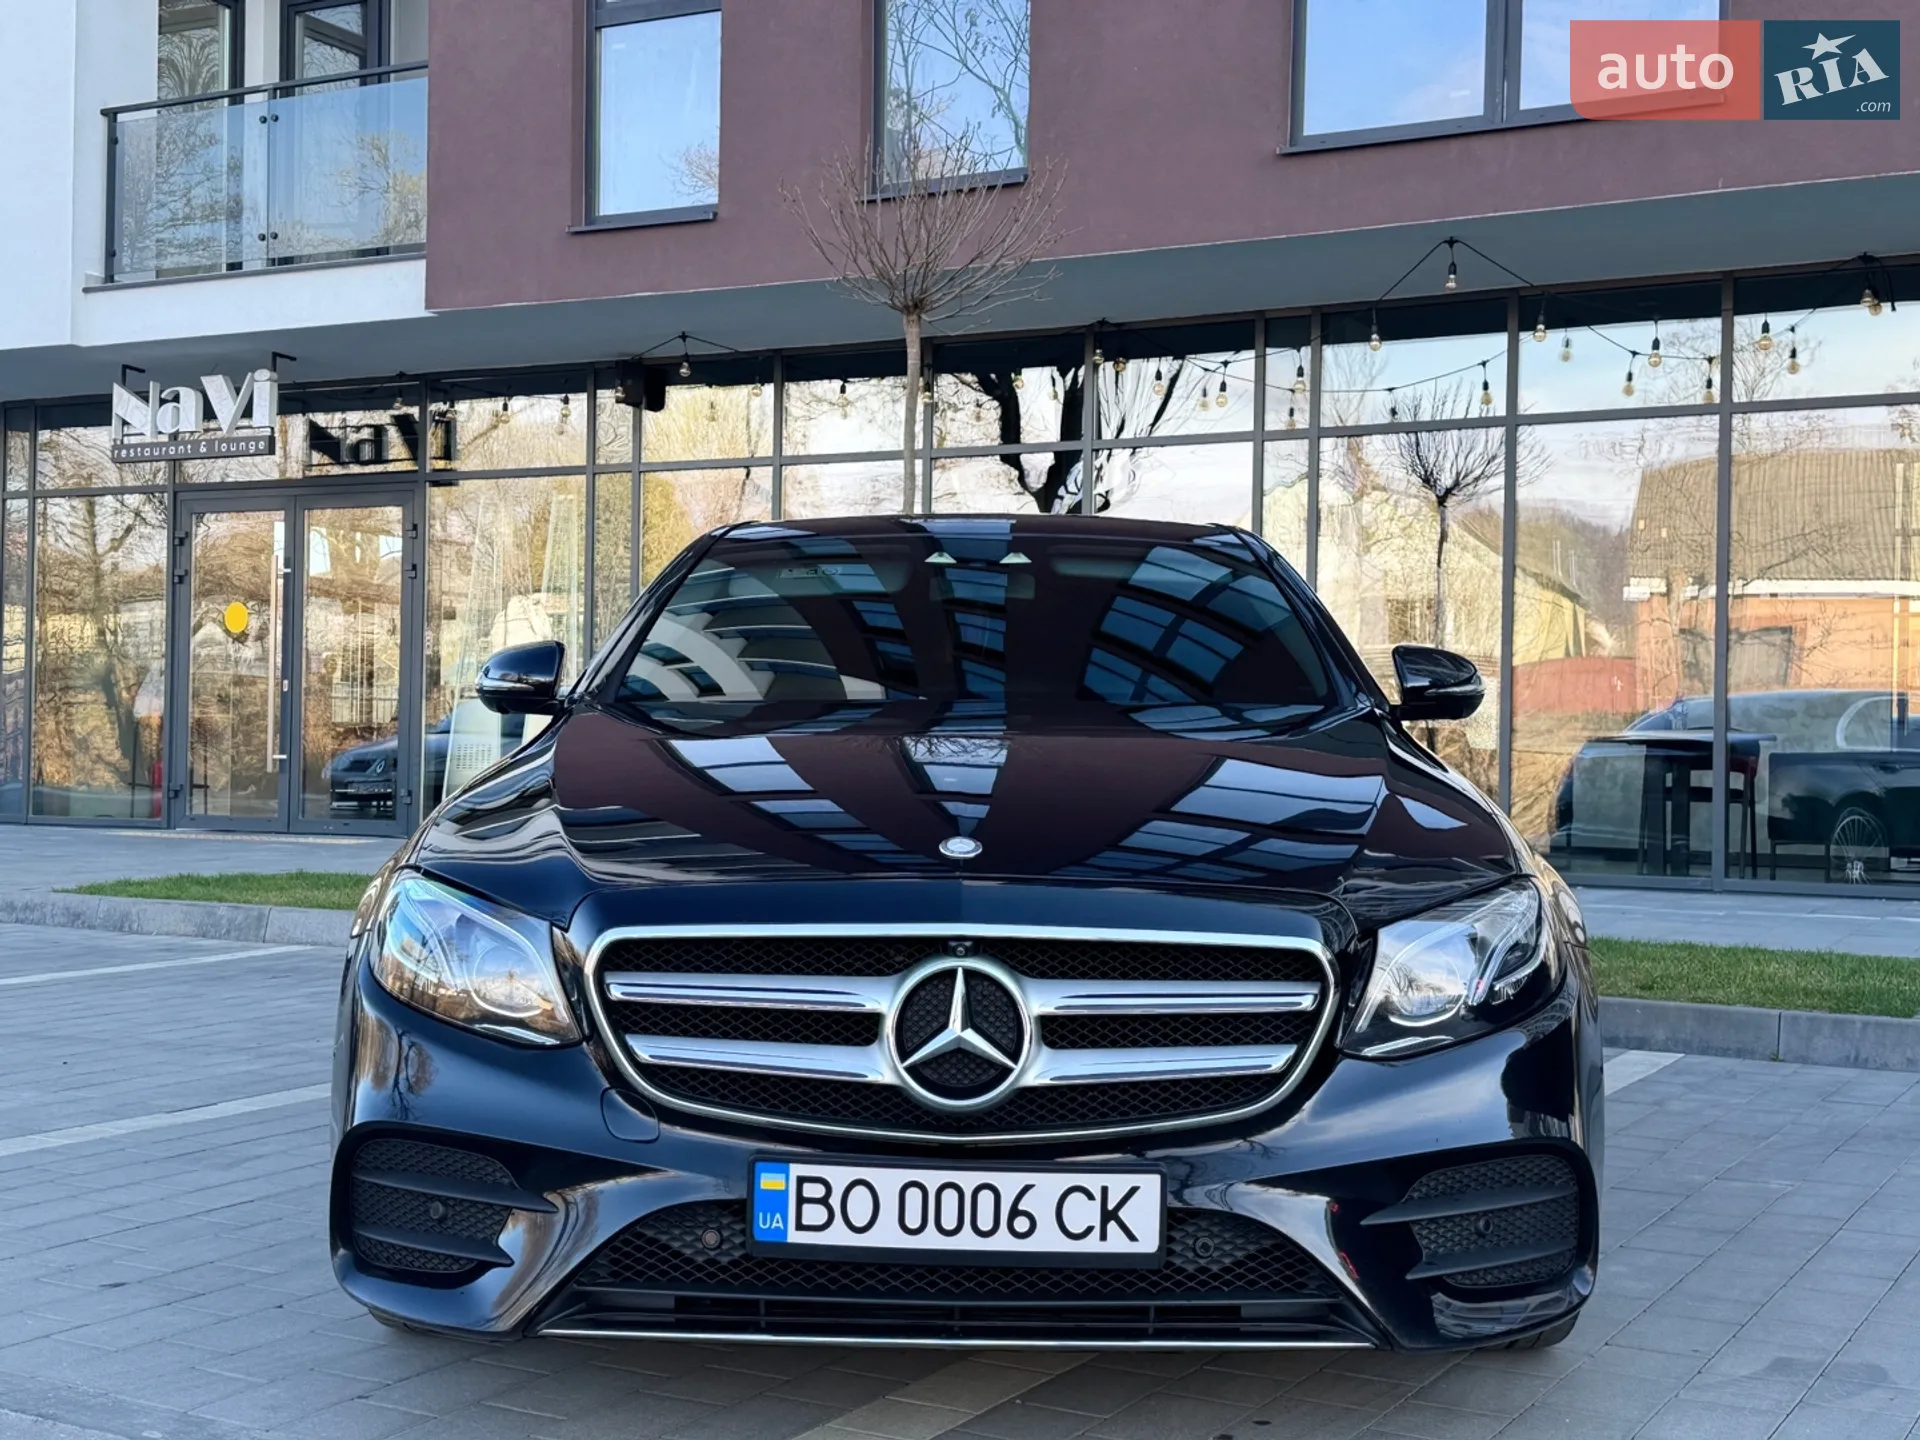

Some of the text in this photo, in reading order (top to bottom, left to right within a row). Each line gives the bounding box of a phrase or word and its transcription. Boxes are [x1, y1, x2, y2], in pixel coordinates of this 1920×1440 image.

[112, 368, 278, 440] NaVi
[114, 440, 266, 459] restaurant & lounge
[758, 1211, 784, 1230] UA
[795, 1175, 1141, 1243] BO 0006 CK
